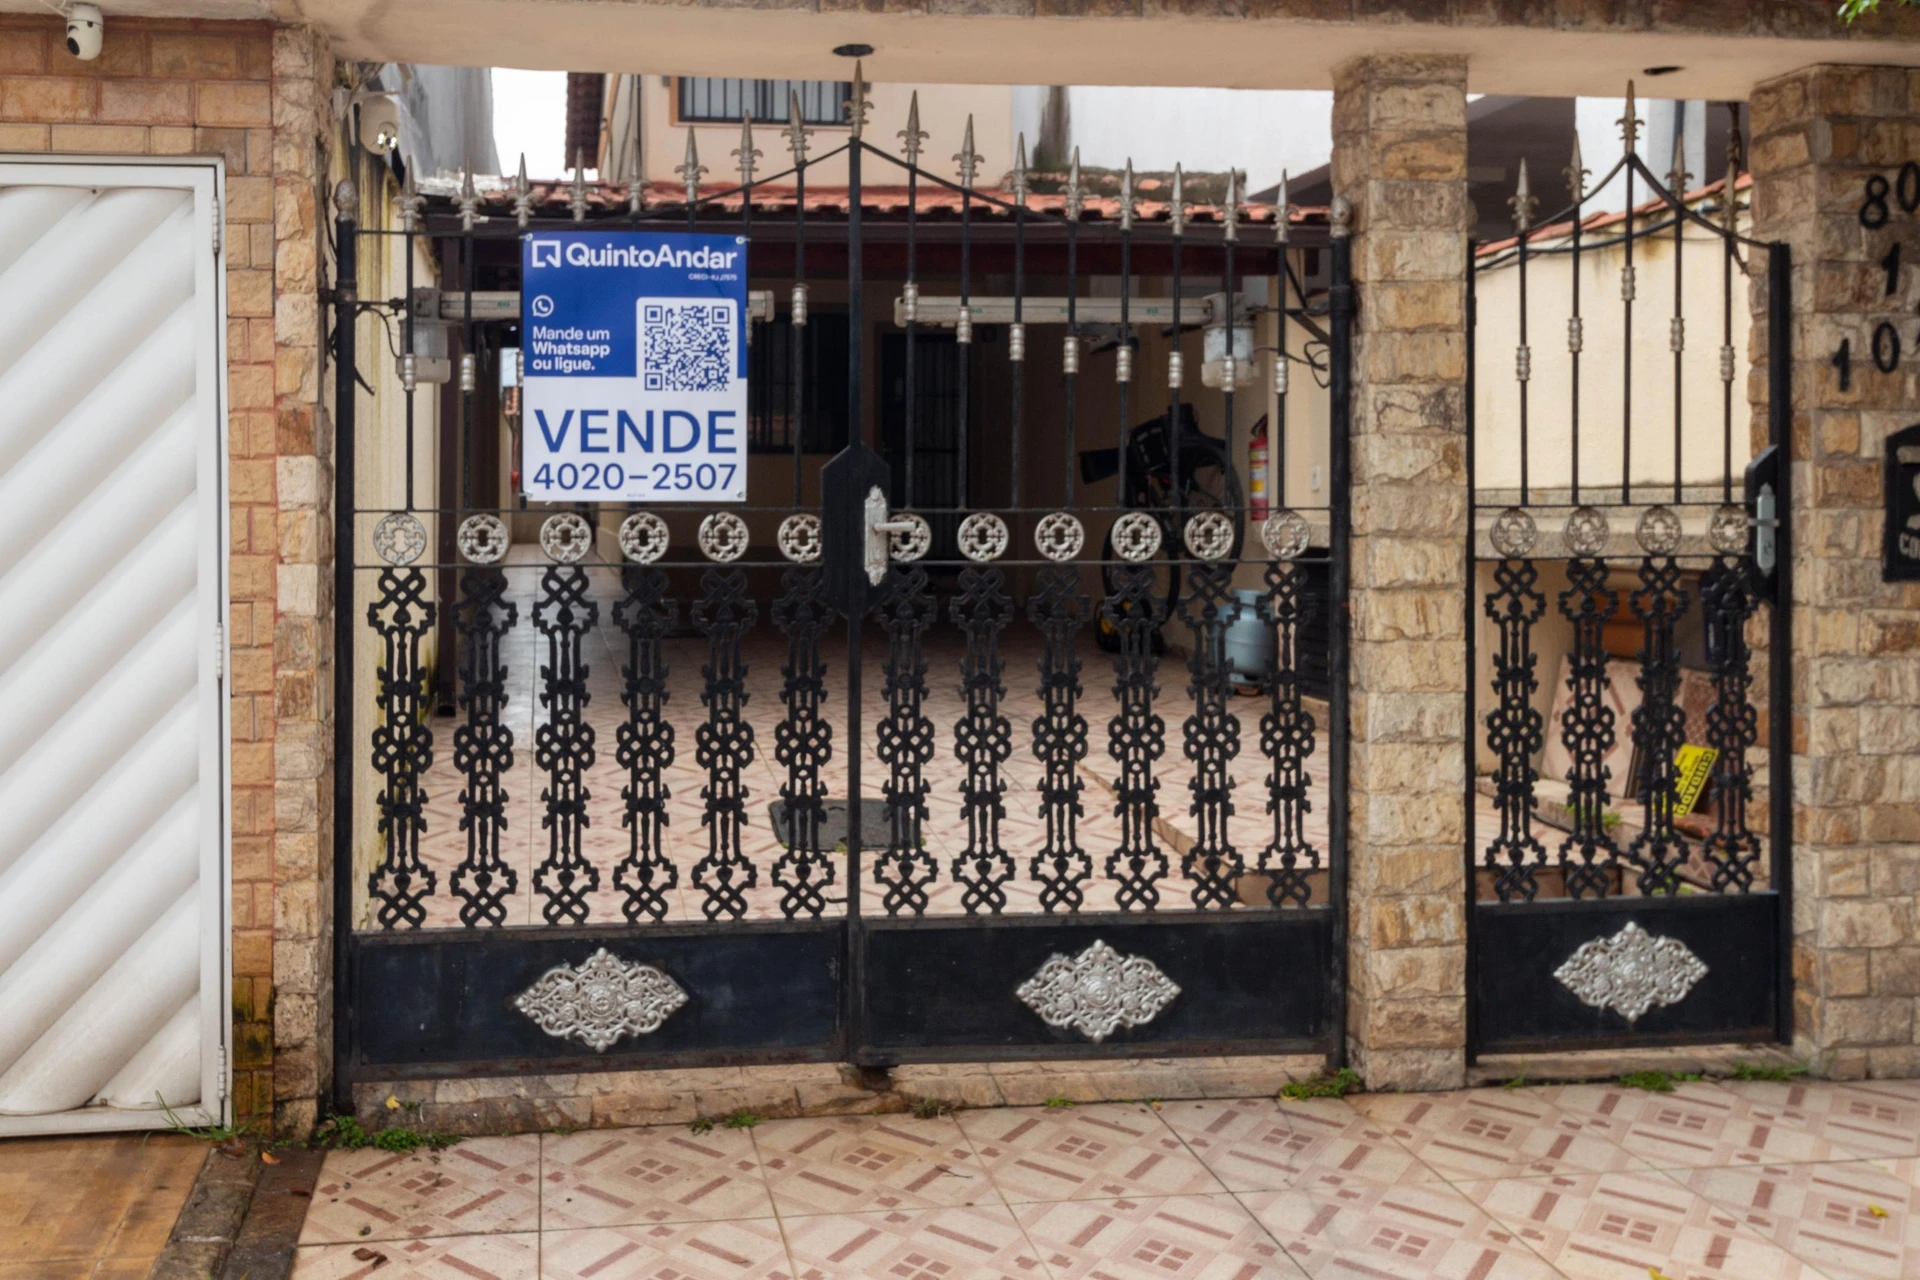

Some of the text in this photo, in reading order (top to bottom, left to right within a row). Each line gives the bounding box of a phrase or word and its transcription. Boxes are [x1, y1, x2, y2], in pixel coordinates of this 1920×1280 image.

[566, 242, 737, 269] QuintoAndar
[532, 327, 610, 341] Mande um
[532, 342, 610, 358] Whatsapp
[532, 357, 596, 373] ou ligue.
[534, 409, 737, 454] VENDE
[533, 462, 737, 491] 4020-2507
[1676, 750, 1716, 816] CUIDADO
